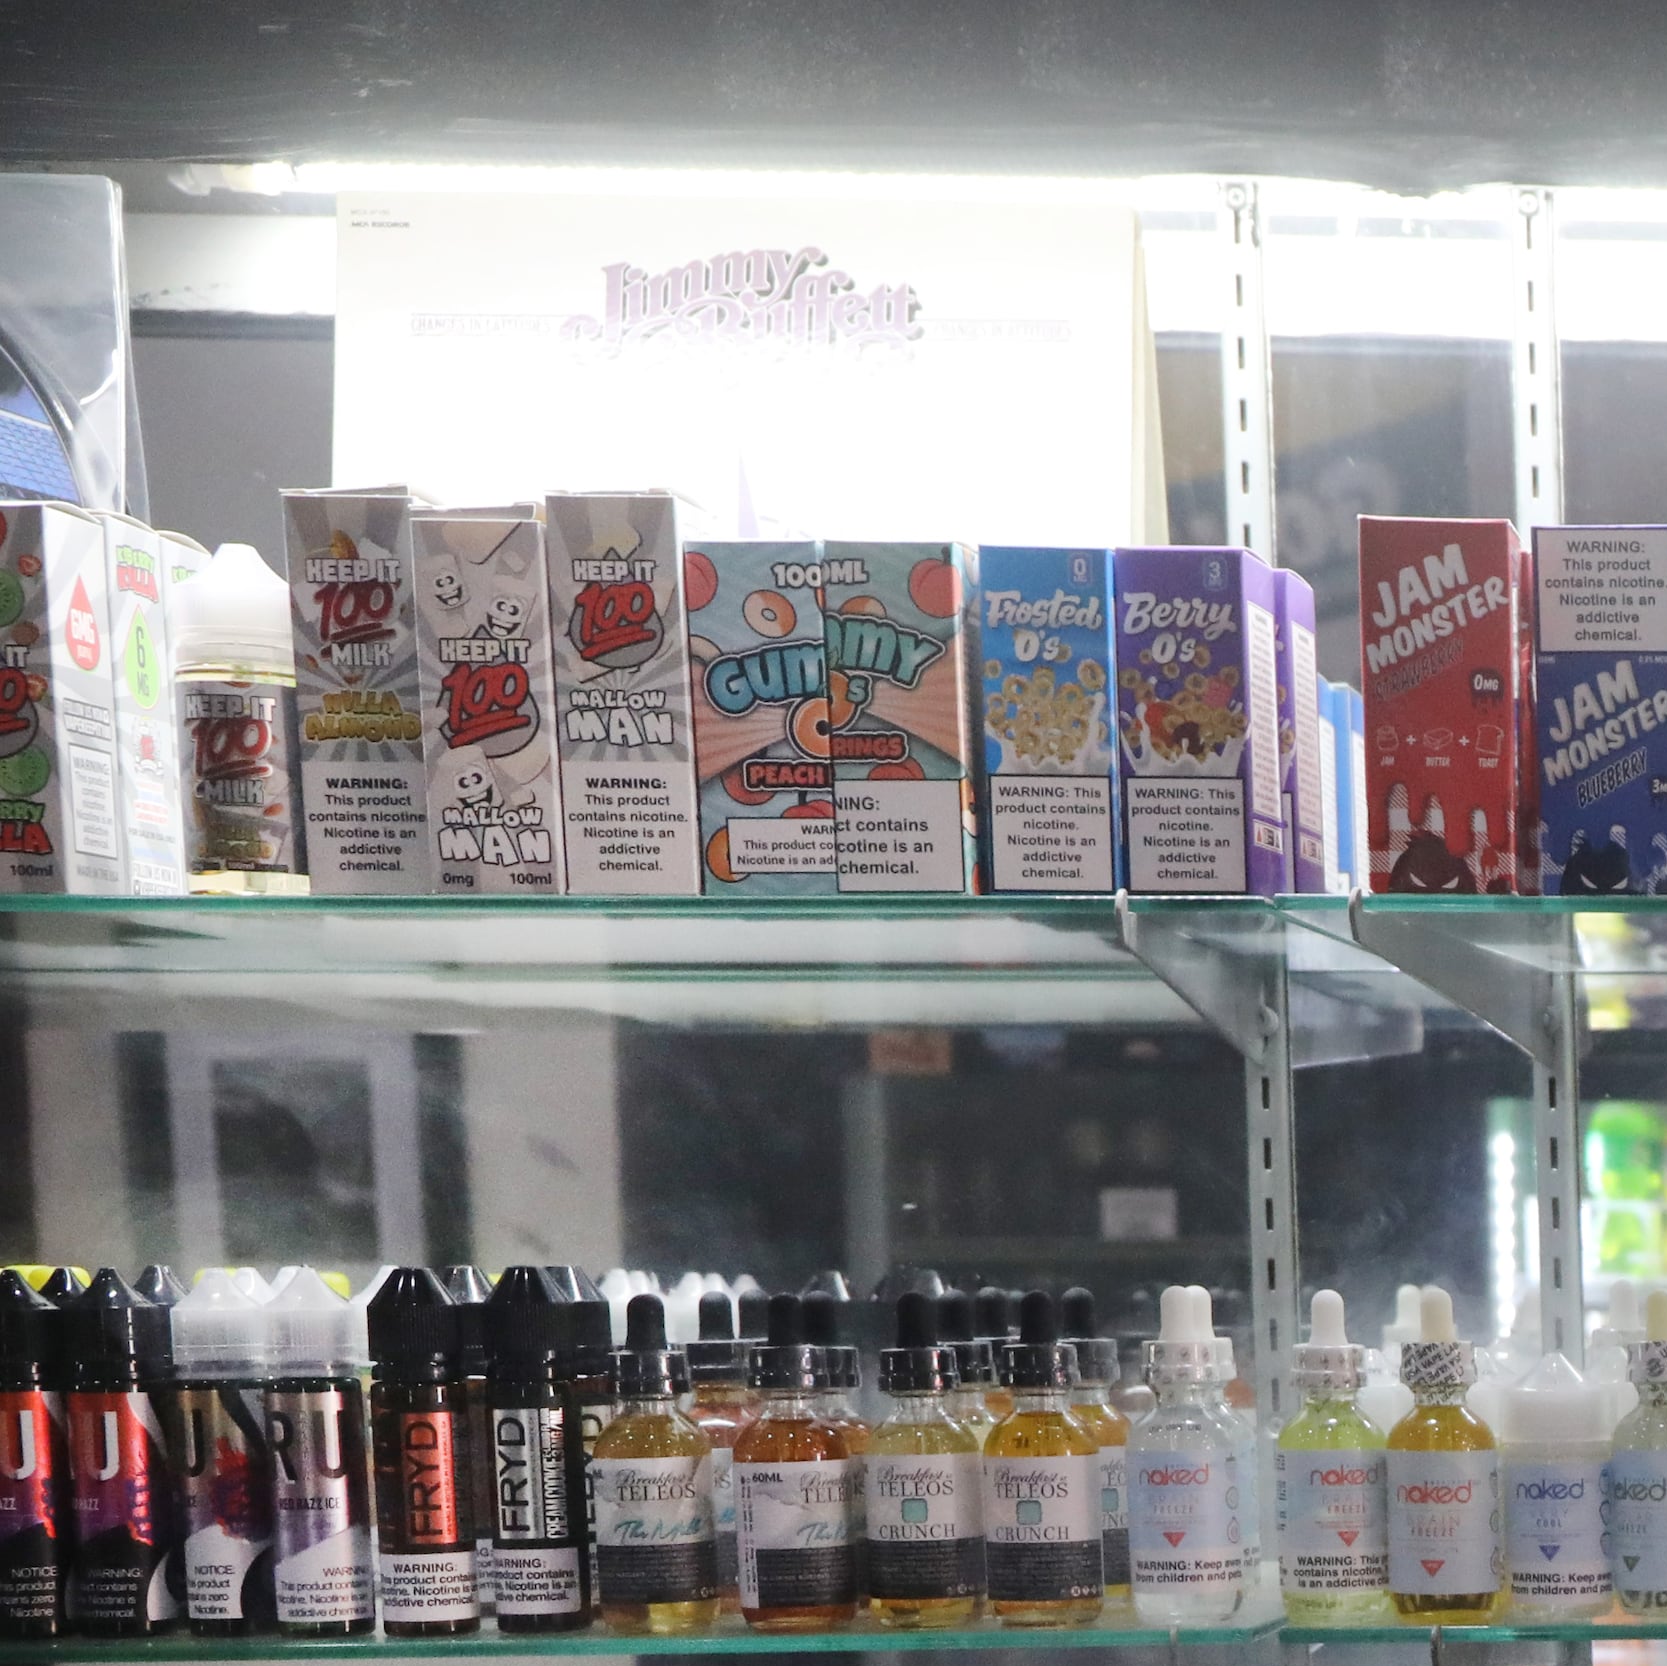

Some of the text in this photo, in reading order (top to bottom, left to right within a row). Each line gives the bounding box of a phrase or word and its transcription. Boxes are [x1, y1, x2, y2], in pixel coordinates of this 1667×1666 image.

[602, 246, 828, 338] Jimmy
[1567, 541, 1645, 553] WARNING:
[306, 558, 400, 582] KEEP IT
[571, 558, 655, 582] KEEP IT
[1562, 558, 1650, 574] This product
[1373, 544, 1468, 628] JAM
[1546, 576, 1603, 589] contains
[986, 590, 1102, 630] Frosted
[1560, 594, 1617, 606] Nicotine
[316, 583, 395, 640] 100
[575, 583, 654, 640] 100
[1123, 592, 1237, 639] Berry
[1577, 611, 1639, 623] addictive
[1366, 576, 1510, 674] MONSTER
[1575, 628, 1641, 641] chemical.
[331, 643, 391, 667] MILK
[440, 638, 531, 662] KEEP IT
[1015, 633, 1059, 662] O's
[1151, 633, 1195, 664] O's
[442, 663, 528, 733] 100
[571, 689, 665, 710] MALLOW
[1548, 660, 1639, 742] JAM
[566, 707, 672, 747] MAN
[833, 736, 903, 756] RINGS
[586, 778, 666, 789] WARNING:
[750, 765, 825, 786] PEACH
[1578, 748, 1647, 808] BLUEBERRY
[583, 794, 671, 807] This product
[442, 806, 543, 827] MALLOW
[568, 811, 689, 822] contains nicotine.
[582, 827, 638, 839] Nicotine
[439, 823, 551, 866] MAN
[599, 843, 660, 856] addictive
[597, 860, 663, 872] chemical.
[442, 872, 552, 886] 0mg 100ml
[406, 1420, 443, 1538] FRYD
[498, 1416, 529, 1532] FRYD
[752, 1473, 783, 1483] 60ML
[1139, 1465, 1209, 1486] naked
[1310, 1465, 1378, 1486] naked
[616, 1483, 696, 1501] TELEOS
[879, 1480, 954, 1497] TELEOS
[993, 1481, 1069, 1498] TELEOS
[1397, 1480, 1472, 1503] naked
[1516, 1477, 1585, 1499] naked
[879, 1523, 956, 1539] CRUNCH
[996, 1525, 1070, 1540] CRUNCH
